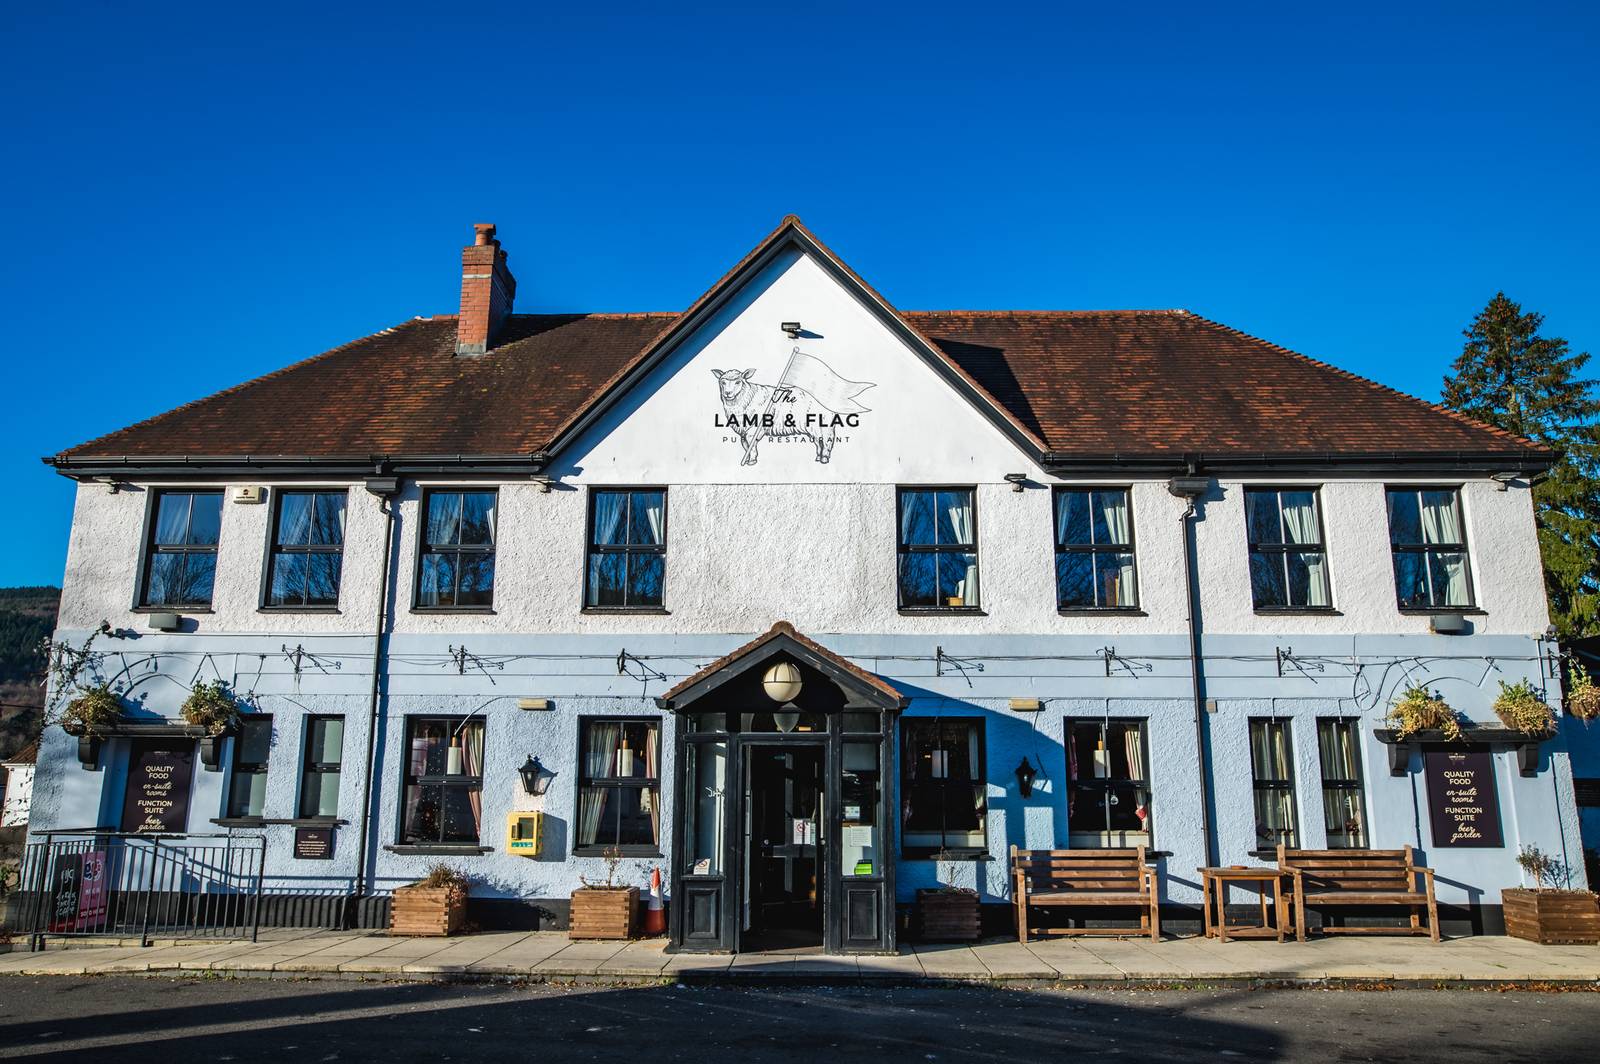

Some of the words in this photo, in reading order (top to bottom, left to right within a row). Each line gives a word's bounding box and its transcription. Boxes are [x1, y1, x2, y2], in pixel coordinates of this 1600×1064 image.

[772, 389, 797, 403] The
[714, 413, 774, 427] LAMB
[784, 413, 796, 427] &
[806, 413, 860, 427] FLAG
[143, 782, 172, 790] en-suite
[1446, 787, 1477, 796] en-suite
[145, 815, 162, 824] beer
[136, 825, 165, 833] garden
[1458, 823, 1476, 833] beer
[1451, 832, 1482, 843] garden
